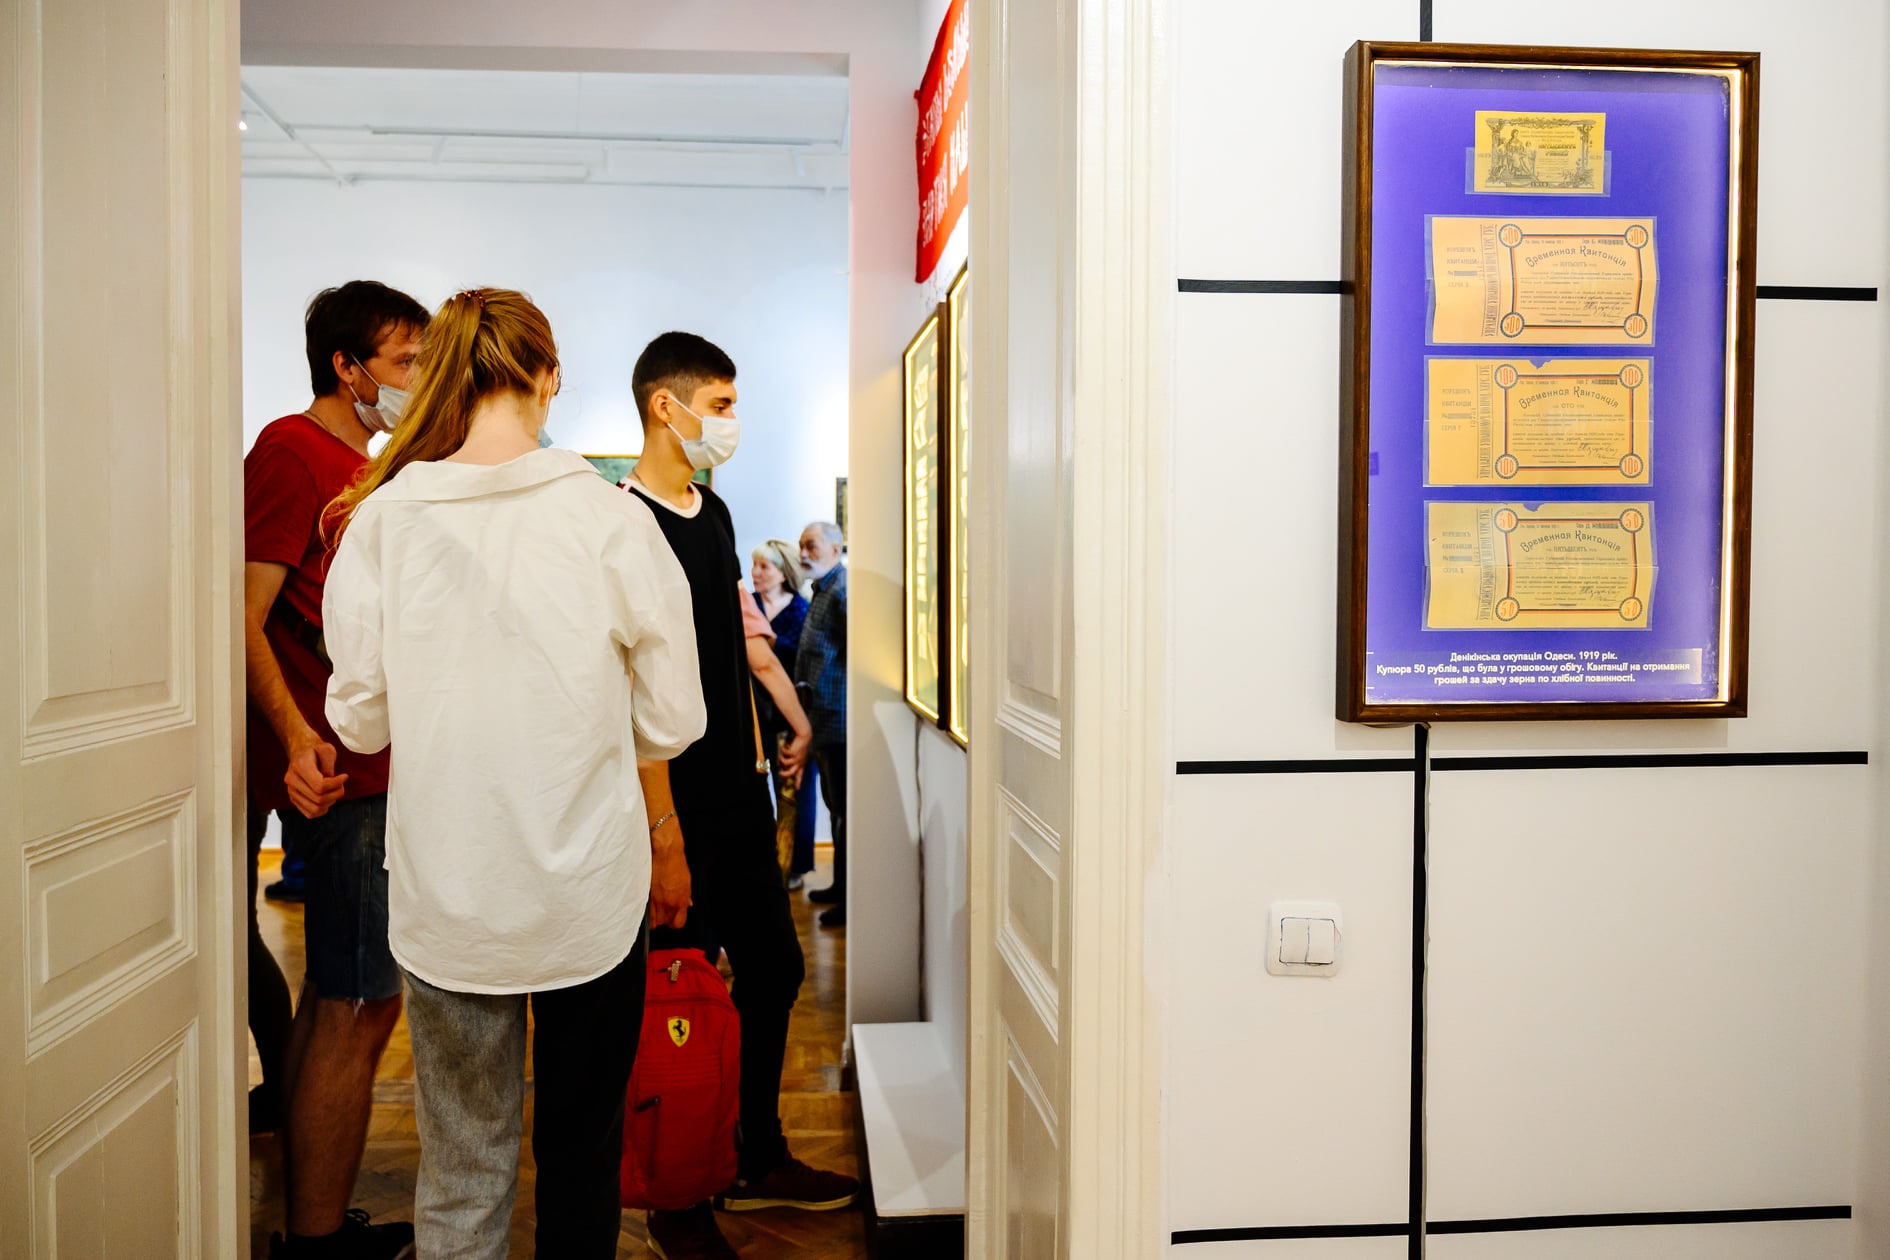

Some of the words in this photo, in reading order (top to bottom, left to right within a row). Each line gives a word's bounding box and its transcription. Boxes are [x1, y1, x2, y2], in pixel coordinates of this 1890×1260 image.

[1499, 367, 1514, 385] 100
[1624, 367, 1639, 386] 100
[1518, 388, 1570, 410] Временная
[1573, 385, 1620, 409] Квитанція
[1499, 457, 1514, 476] 100
[1624, 457, 1639, 475] 100
[1500, 512, 1513, 529] 50
[1625, 512, 1640, 529] 50
[1520, 532, 1571, 553] Временная
[1575, 530, 1622, 552] Квитанція
[1501, 600, 1515, 617] 50
[1624, 599, 1639, 618] 50
[1450, 652, 1501, 663] Денікінська
[1503, 652, 1543, 662] окупація
[1544, 651, 1576, 661] Одеси.
[1579, 650, 1600, 660] 1919
[1601, 650, 1618, 662] рік.
[1376, 664, 1412, 676] Купюра
[1413, 663, 1426, 674] 50
[1427, 663, 1460, 675] рублів,
[1462, 665, 1476, 674] що
[1477, 662, 1498, 674] була
[1499, 665, 1505, 674] у
[1507, 664, 1558, 674] грошовому
[1560, 662, 1585, 674] обігу.
[1587, 662, 1629, 672] Квитанції
[1630, 663, 1641, 672] на
[1642, 663, 1690, 673] отримання
[1434, 675, 1468, 686] грошей
[1470, 676, 1480, 684] за
[1482, 676, 1507, 686] здачу
[1509, 675, 1536, 685] зерна
[1538, 675, 1550, 683] по
[1552, 673, 1584, 683] хлібної
[1585, 673, 1636, 683] повинності.
